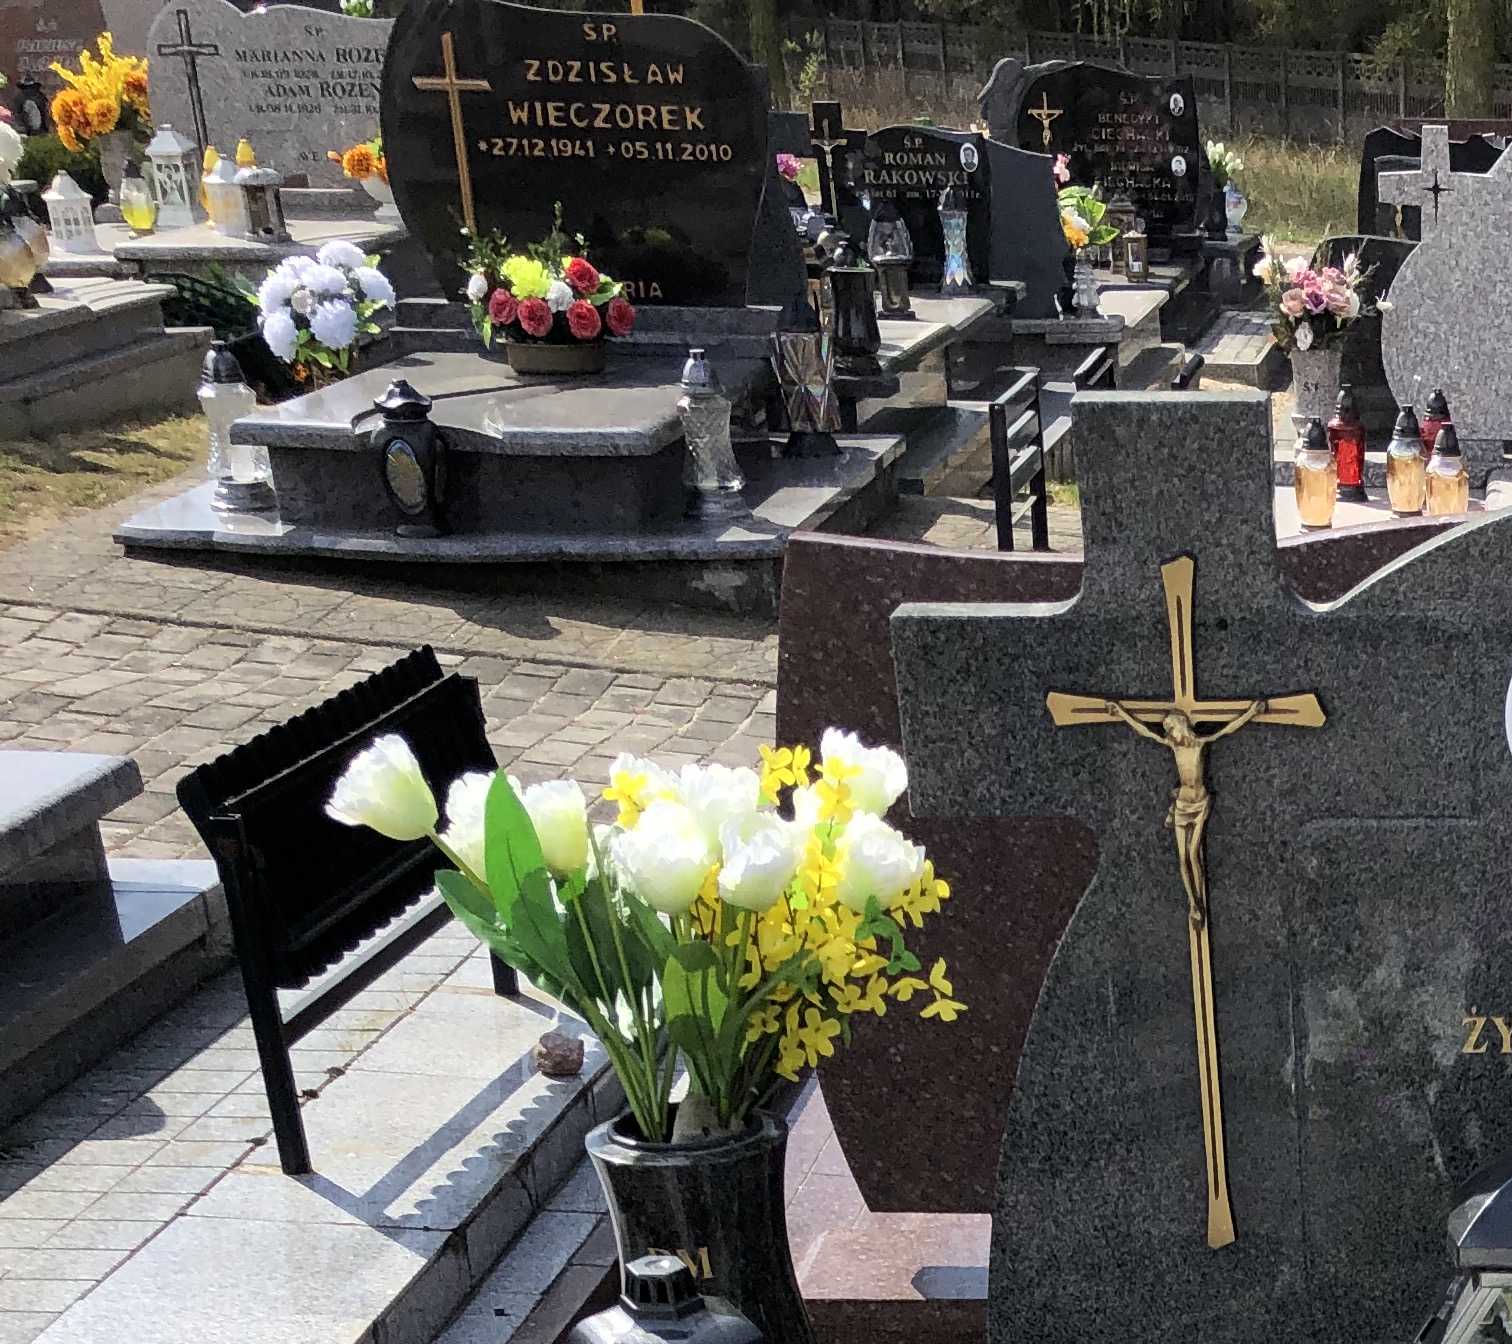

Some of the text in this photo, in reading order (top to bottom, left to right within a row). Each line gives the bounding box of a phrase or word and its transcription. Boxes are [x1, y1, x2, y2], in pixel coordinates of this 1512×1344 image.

[524, 59, 684, 84] ZDZISŁAW
[507, 101, 705, 131] WIECZOREK
[884, 152, 946, 166] ROMAN
[864, 169, 969, 186] RAKOWSKI
